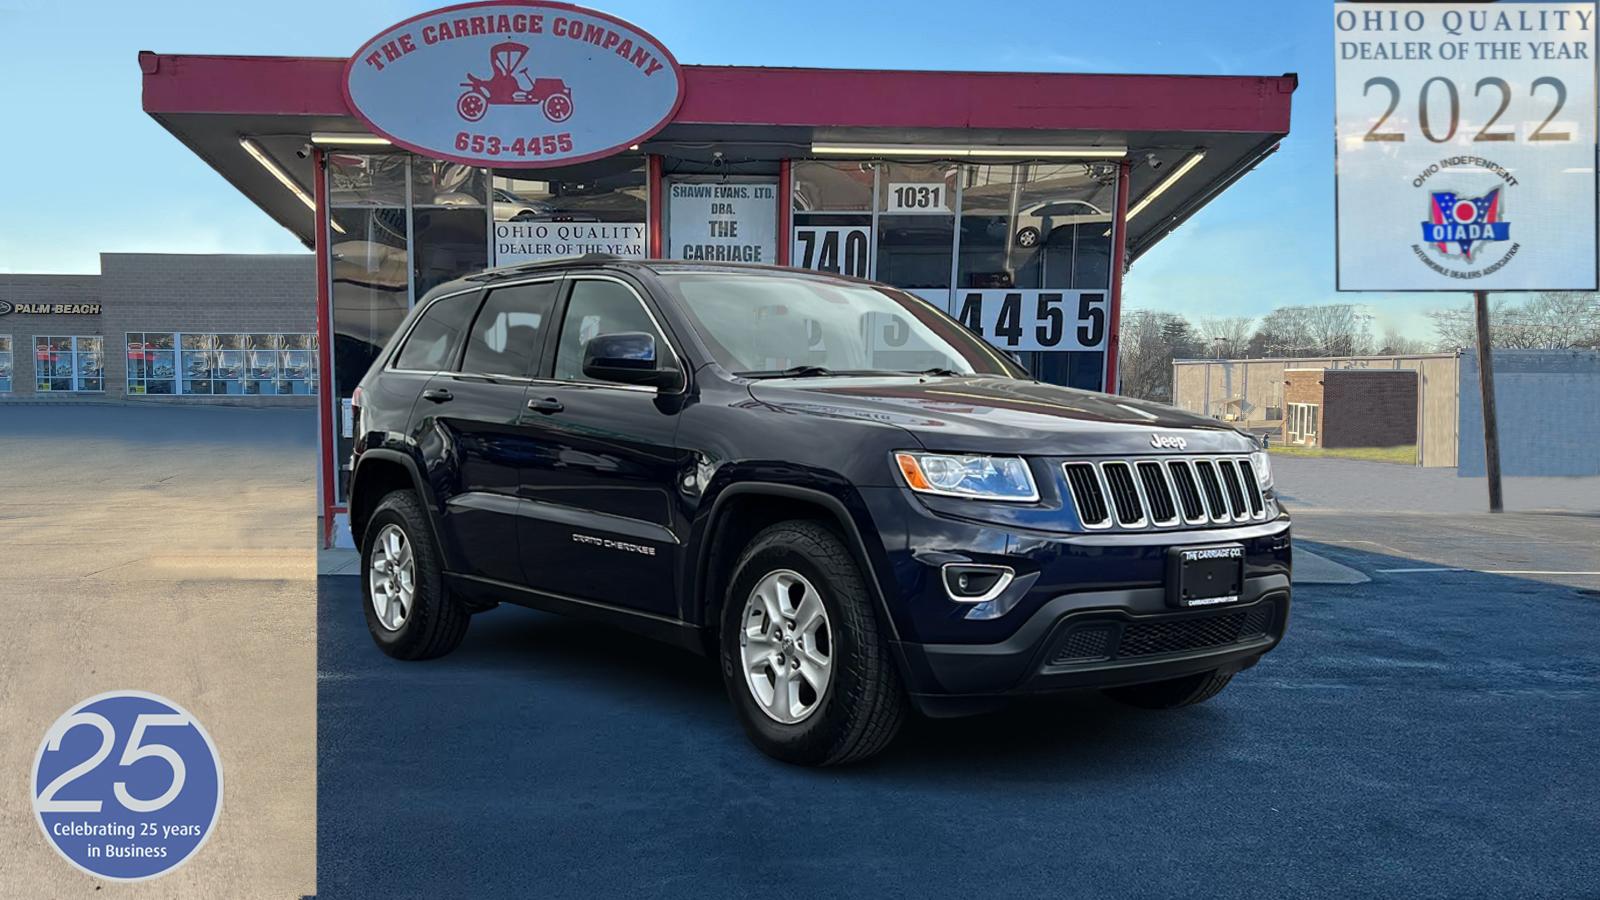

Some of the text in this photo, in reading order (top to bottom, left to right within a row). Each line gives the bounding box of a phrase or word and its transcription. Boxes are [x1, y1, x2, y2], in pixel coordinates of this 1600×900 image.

[1336, 9, 1593, 36] OHIO QUALITY
[365, 14, 664, 77] THE CARRIAGE COMPANY
[1340, 41, 1589, 60] DEALER OF THE YEAR
[1362, 75, 1571, 143] 2022
[454, 132, 573, 157] 653-4455
[1412, 155, 1519, 188] OHIO INDEPENDENT
[672, 185, 712, 199] SHAWN
[754, 185, 775, 199] LTD.
[894, 186, 941, 209] 1031
[711, 203, 736, 216] DBA.
[497, 226, 644, 241] OHIO QUALITY
[708, 220, 738, 238] THE
[1432, 224, 1496, 241] OIADA
[499, 243, 641, 256] DEALER OF THE YEAR
[683, 244, 762, 262] CARRIAGE
[797, 230, 869, 280] 740
[1449, 269, 1483, 280] DEALERS
[15, 303, 51, 314] PALM
[54, 303, 100, 314] BEACH
[959, 293, 1105, 347] 4455
[1151, 434, 1187, 449] Jeep
[604, 539, 655, 555] CHEROKEE
[1186, 551, 1197, 560] THE
